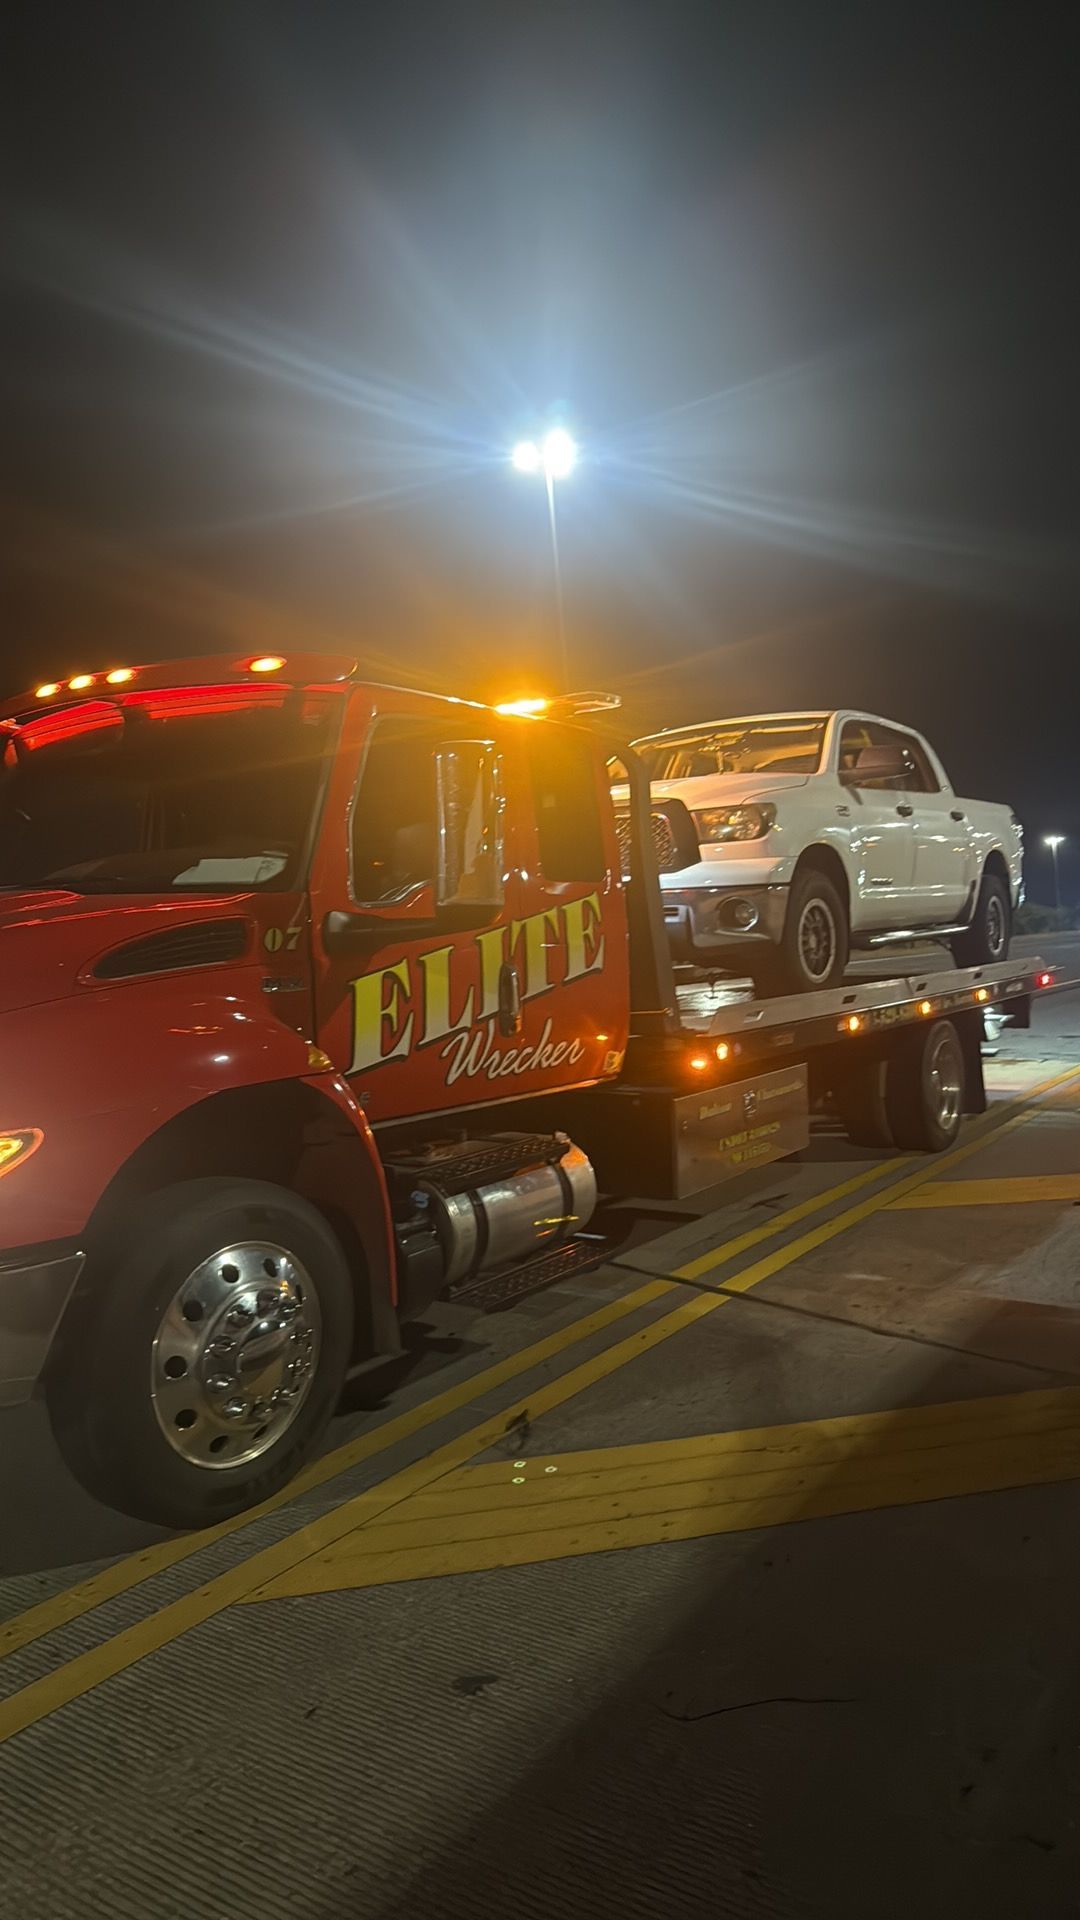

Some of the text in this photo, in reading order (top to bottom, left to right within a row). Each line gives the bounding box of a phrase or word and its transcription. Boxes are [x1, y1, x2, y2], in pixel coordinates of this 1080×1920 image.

[264, 926, 303, 953] 07
[345, 893, 605, 1076] ELITE
[440, 1016, 586, 1086] Wrecker
